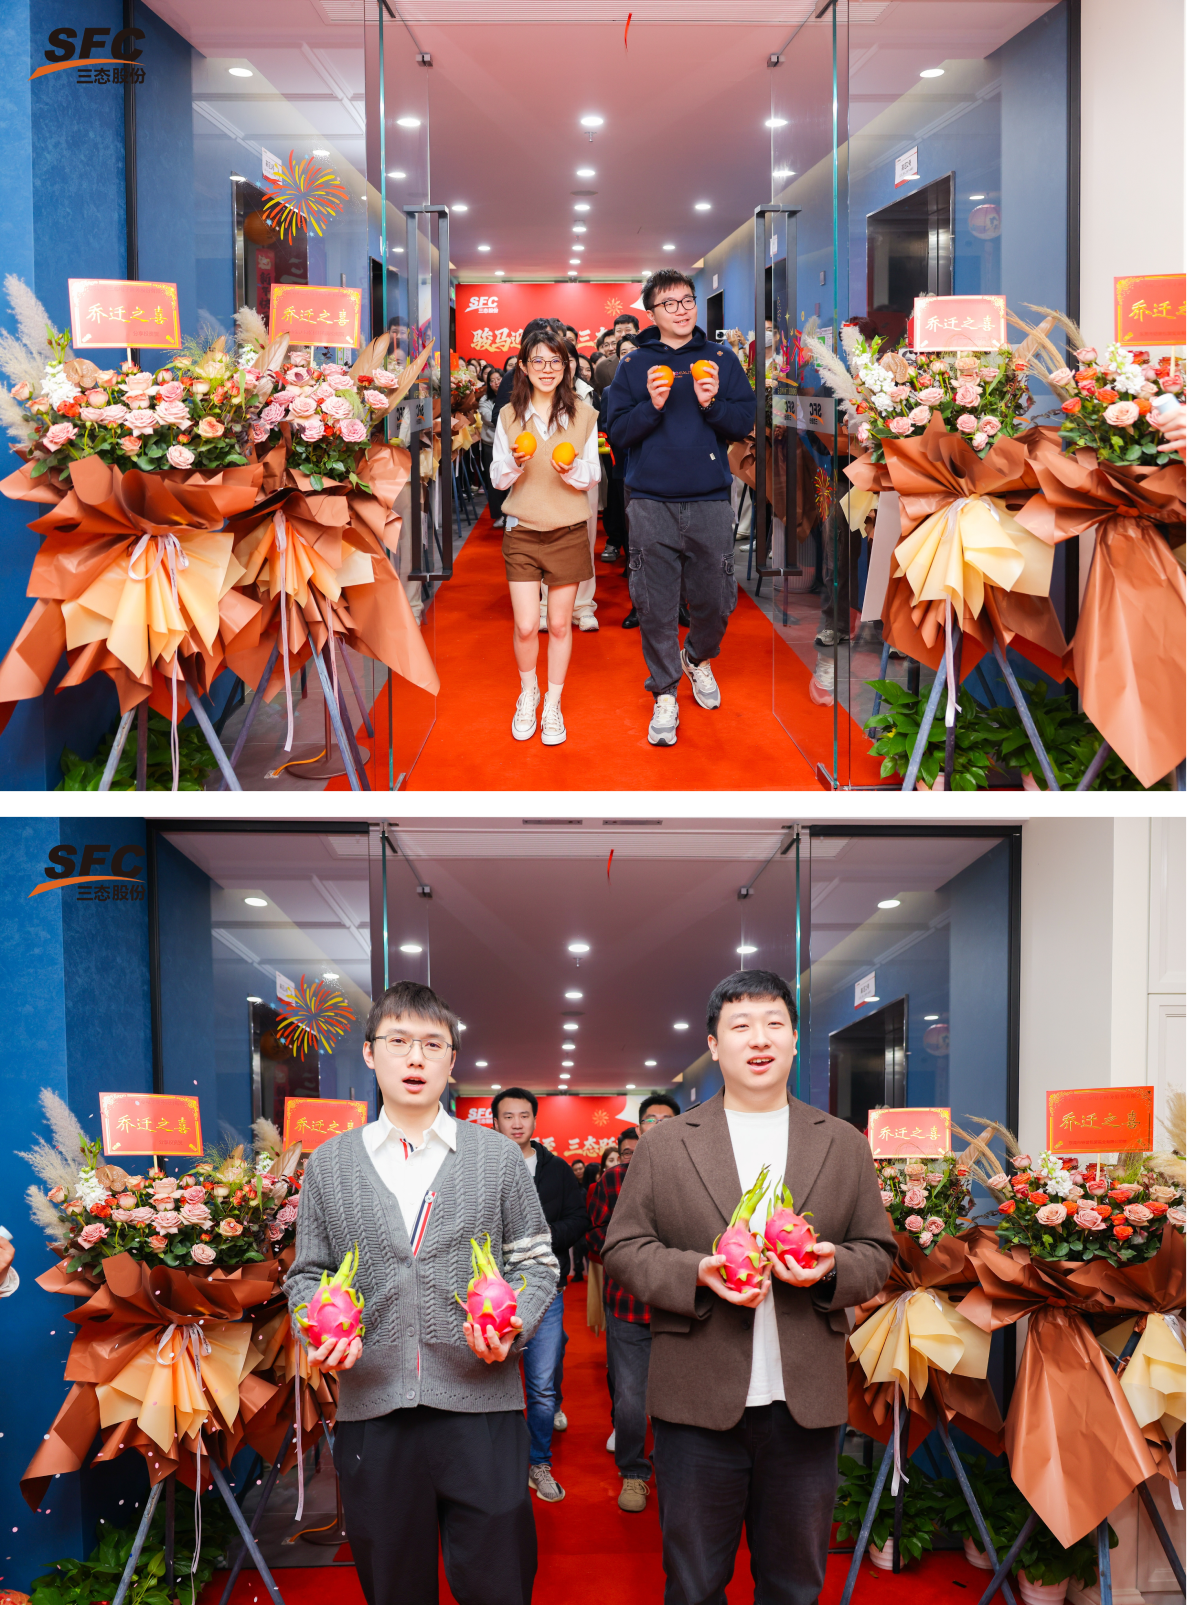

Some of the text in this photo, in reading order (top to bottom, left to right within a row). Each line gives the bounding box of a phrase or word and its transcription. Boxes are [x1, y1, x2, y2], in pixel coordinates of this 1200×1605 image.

[468, 296, 499, 307] SFC
[86, 303, 168, 325] 乔迁之喜
[281, 306, 350, 327] 乔迁之喜
[925, 315, 995, 332] 乔迁之喜
[116, 1115, 191, 1134] 乔迁之喜
[1059, 1110, 1141, 1131] 乔迁之喜
[878, 1125, 941, 1141] 乔迁之喜
